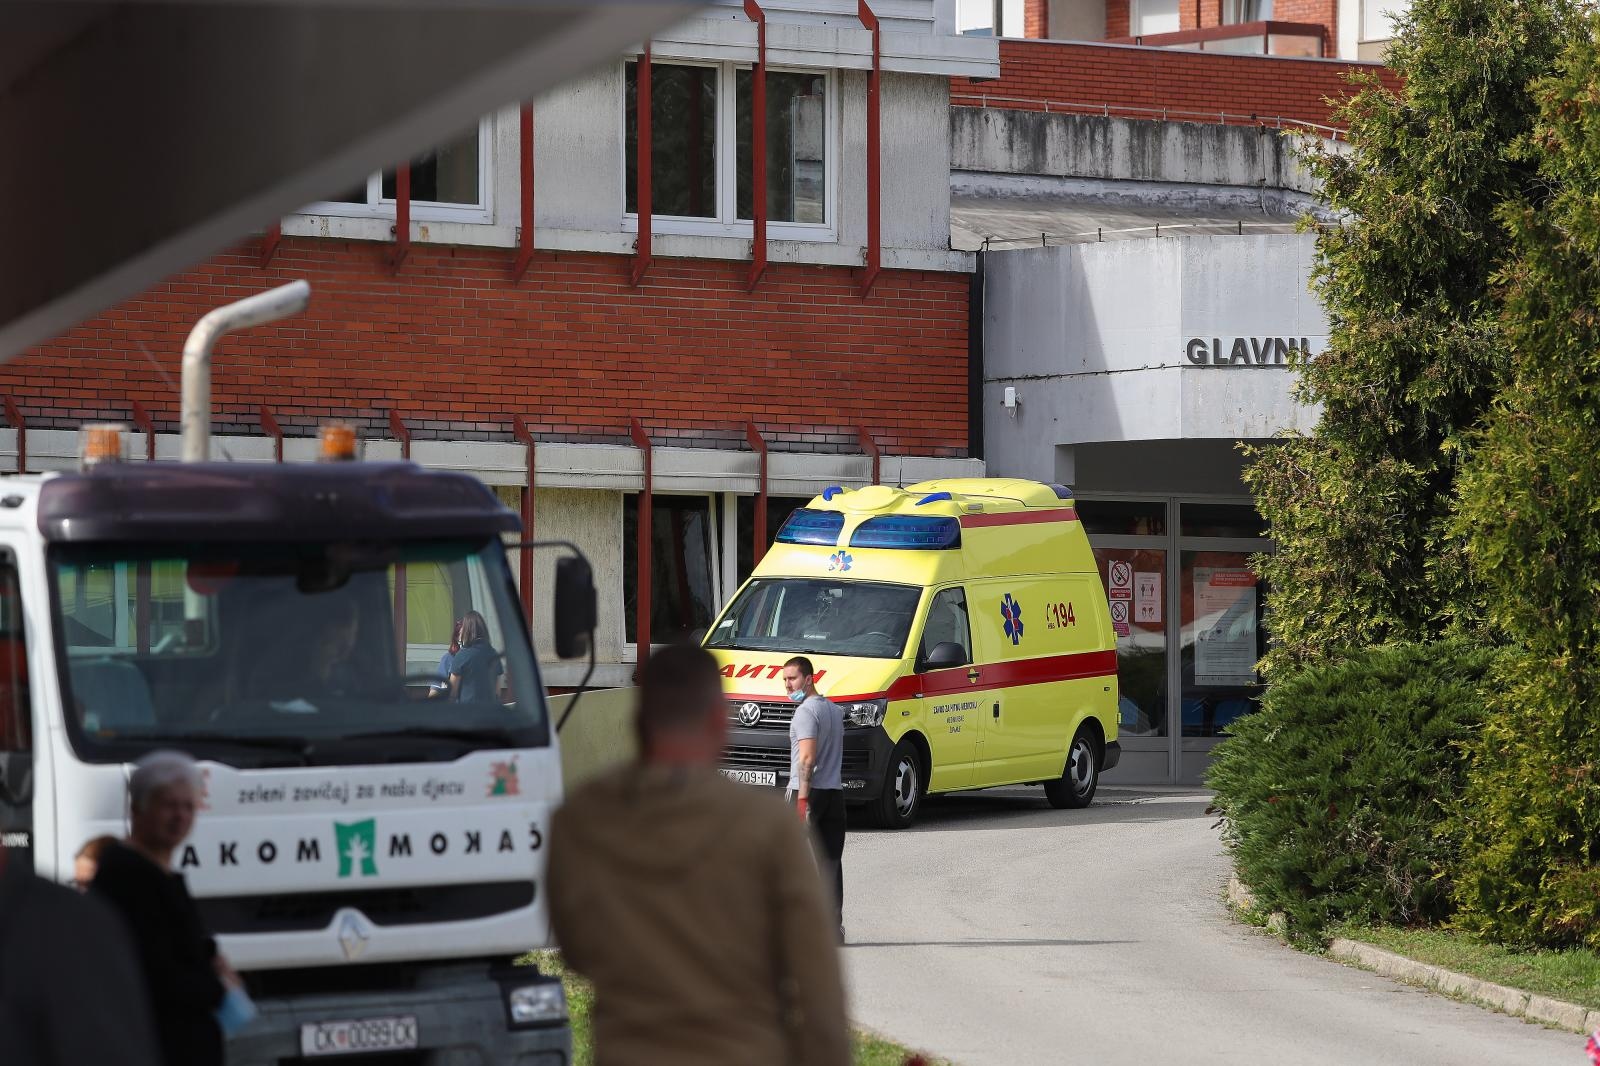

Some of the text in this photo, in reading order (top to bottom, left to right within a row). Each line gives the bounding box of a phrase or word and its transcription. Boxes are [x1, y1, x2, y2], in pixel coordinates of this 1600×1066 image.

[1186, 337, 1309, 365] GLAVNI
[1052, 601, 1076, 628] 194
[238, 782, 286, 804] zeleni
[356, 784, 375, 799] za
